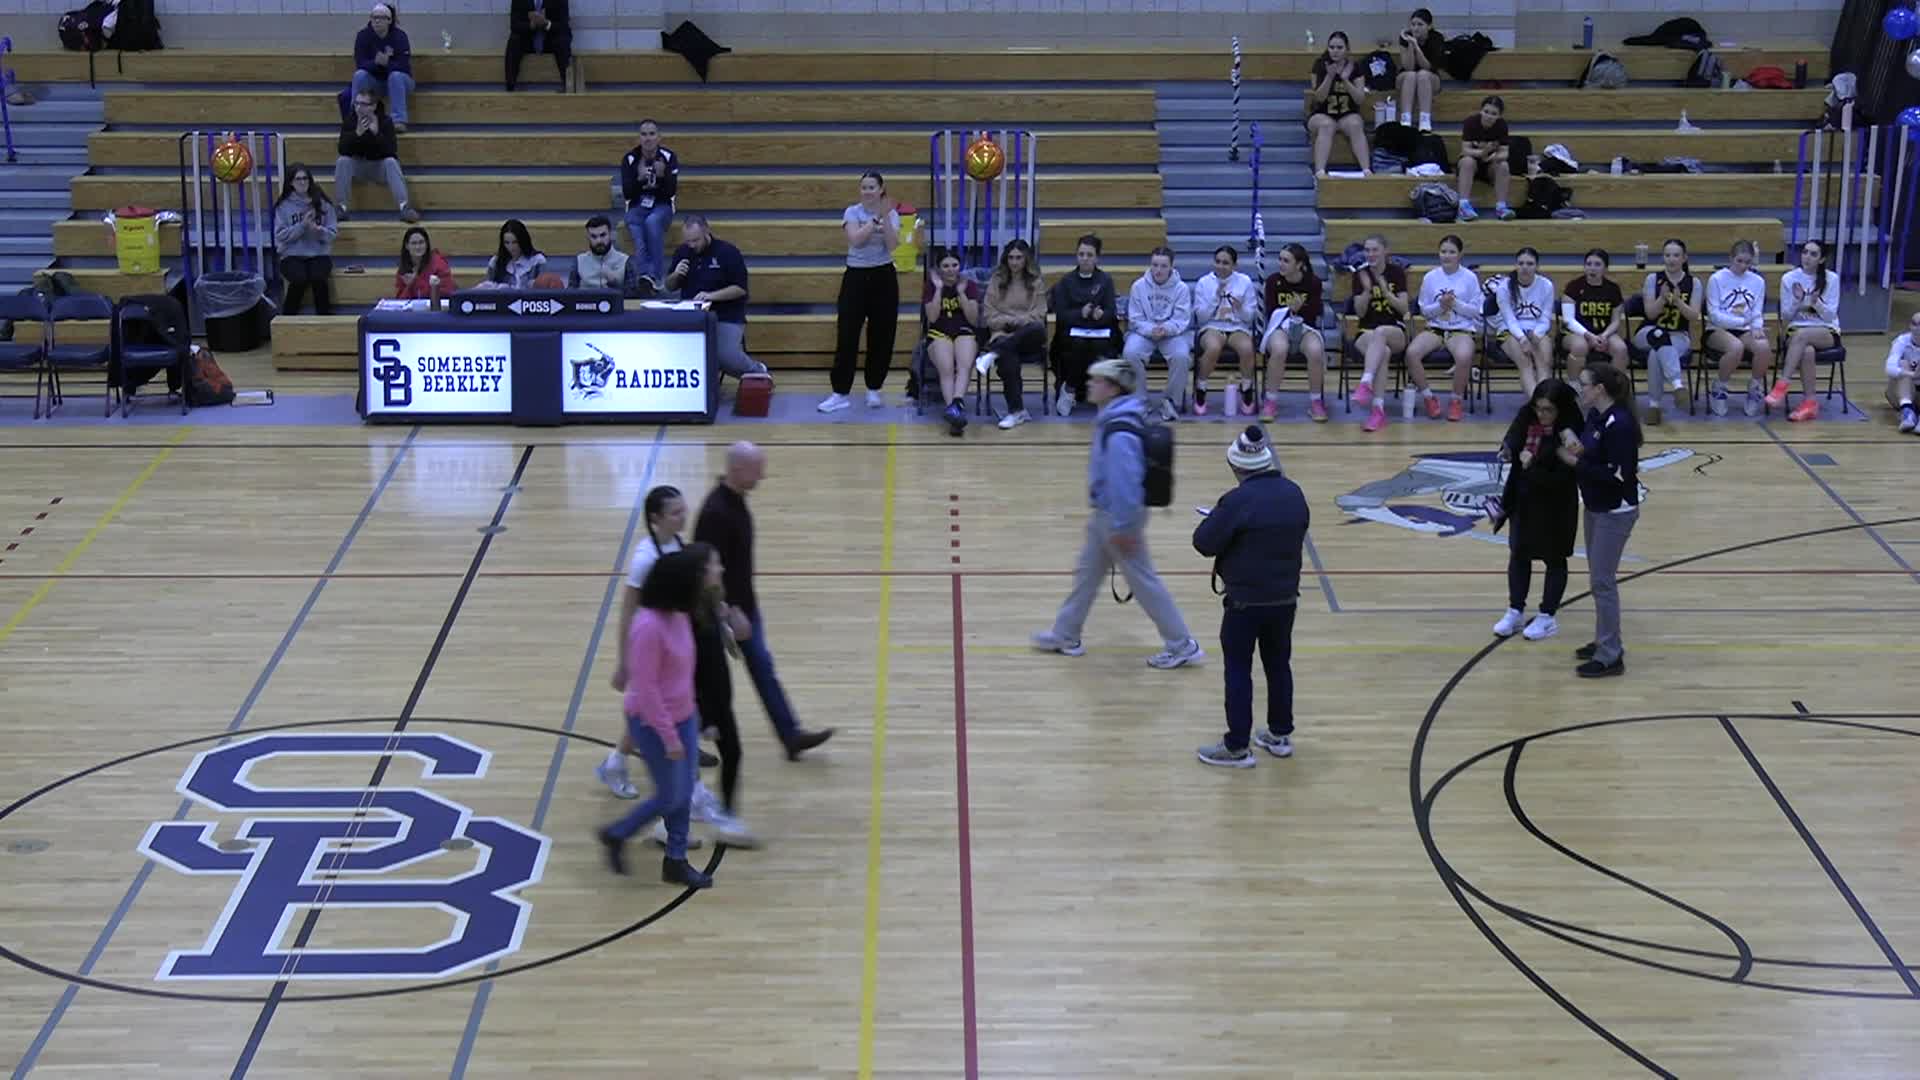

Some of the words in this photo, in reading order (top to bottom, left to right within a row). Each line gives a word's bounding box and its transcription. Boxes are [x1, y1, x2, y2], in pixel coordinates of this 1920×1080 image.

[521, 299, 551, 314] POSS
[1657, 307, 1680, 330] 23
[417, 356, 507, 373] SOMERSET
[423, 375, 502, 392] BERKLEY
[615, 368, 702, 389] RAIDERS
